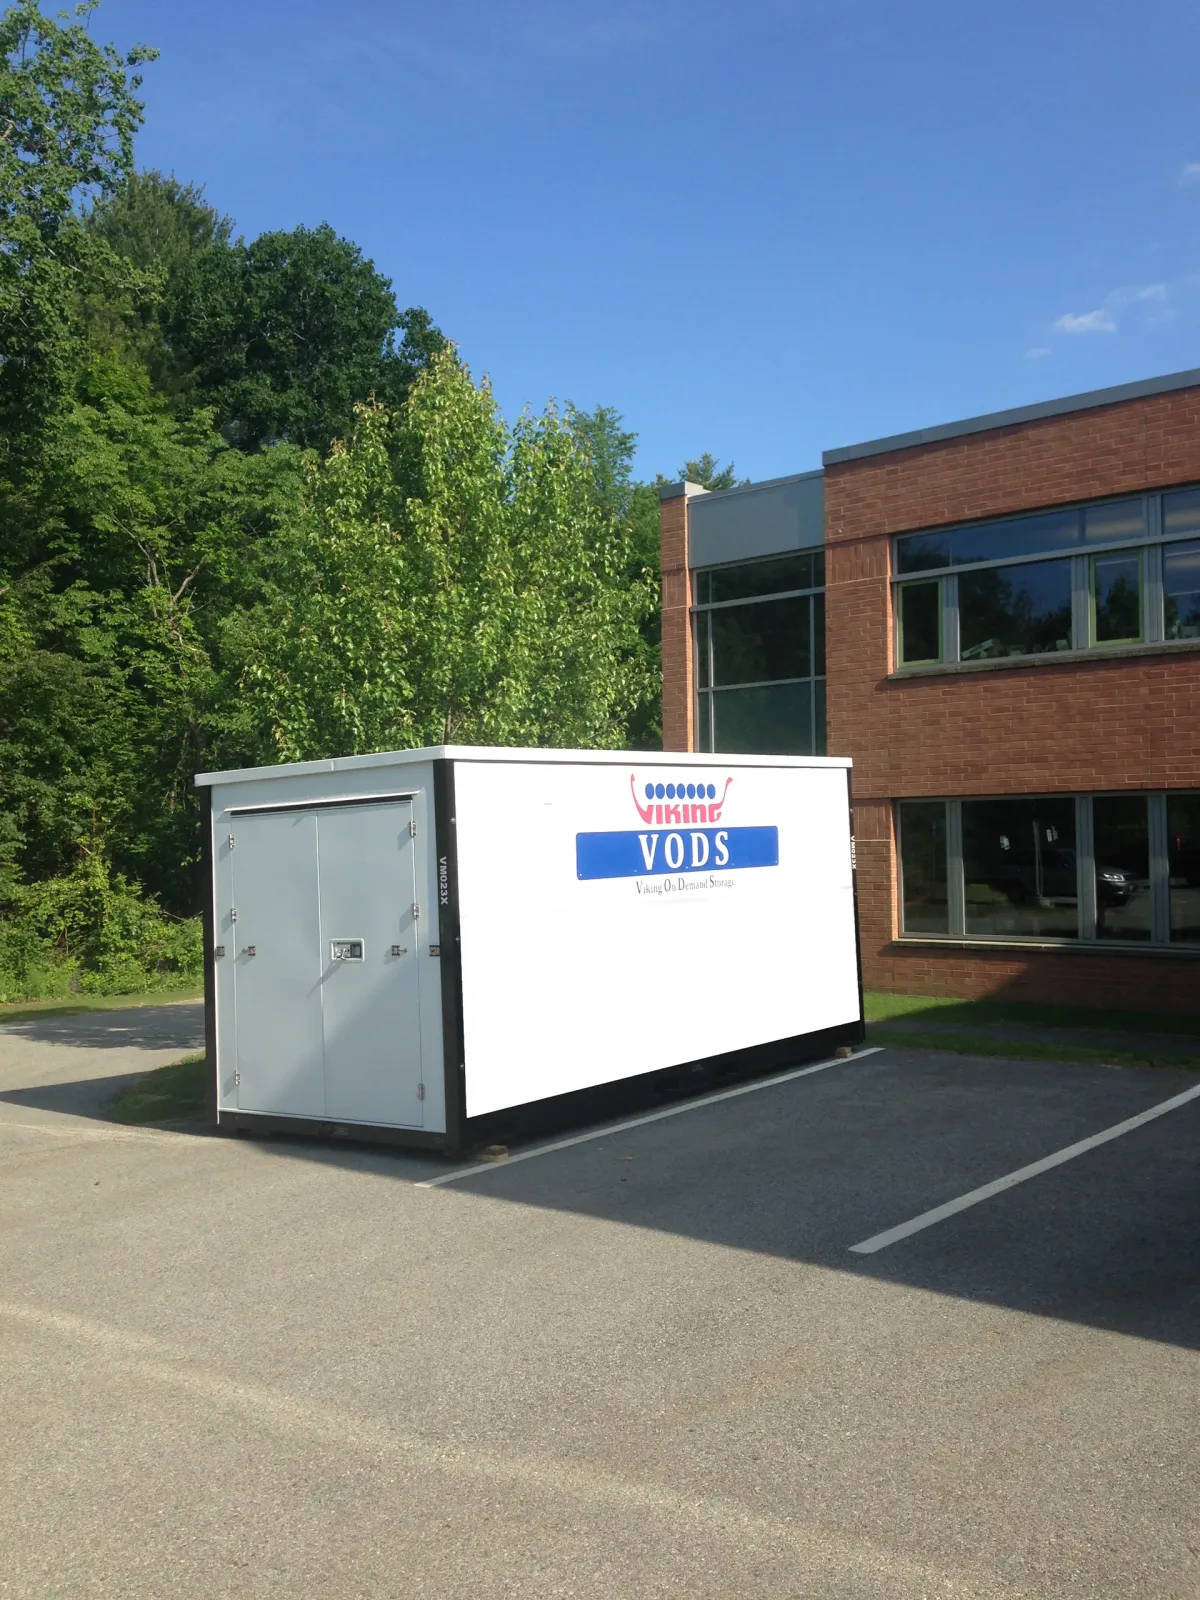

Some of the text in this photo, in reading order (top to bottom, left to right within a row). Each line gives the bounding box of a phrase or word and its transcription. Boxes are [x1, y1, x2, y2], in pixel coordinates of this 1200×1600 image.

[638, 831, 729, 870] VODS
[439, 856, 448, 905] VM023X
[635, 875, 736, 896] Viking On Demand Storage
